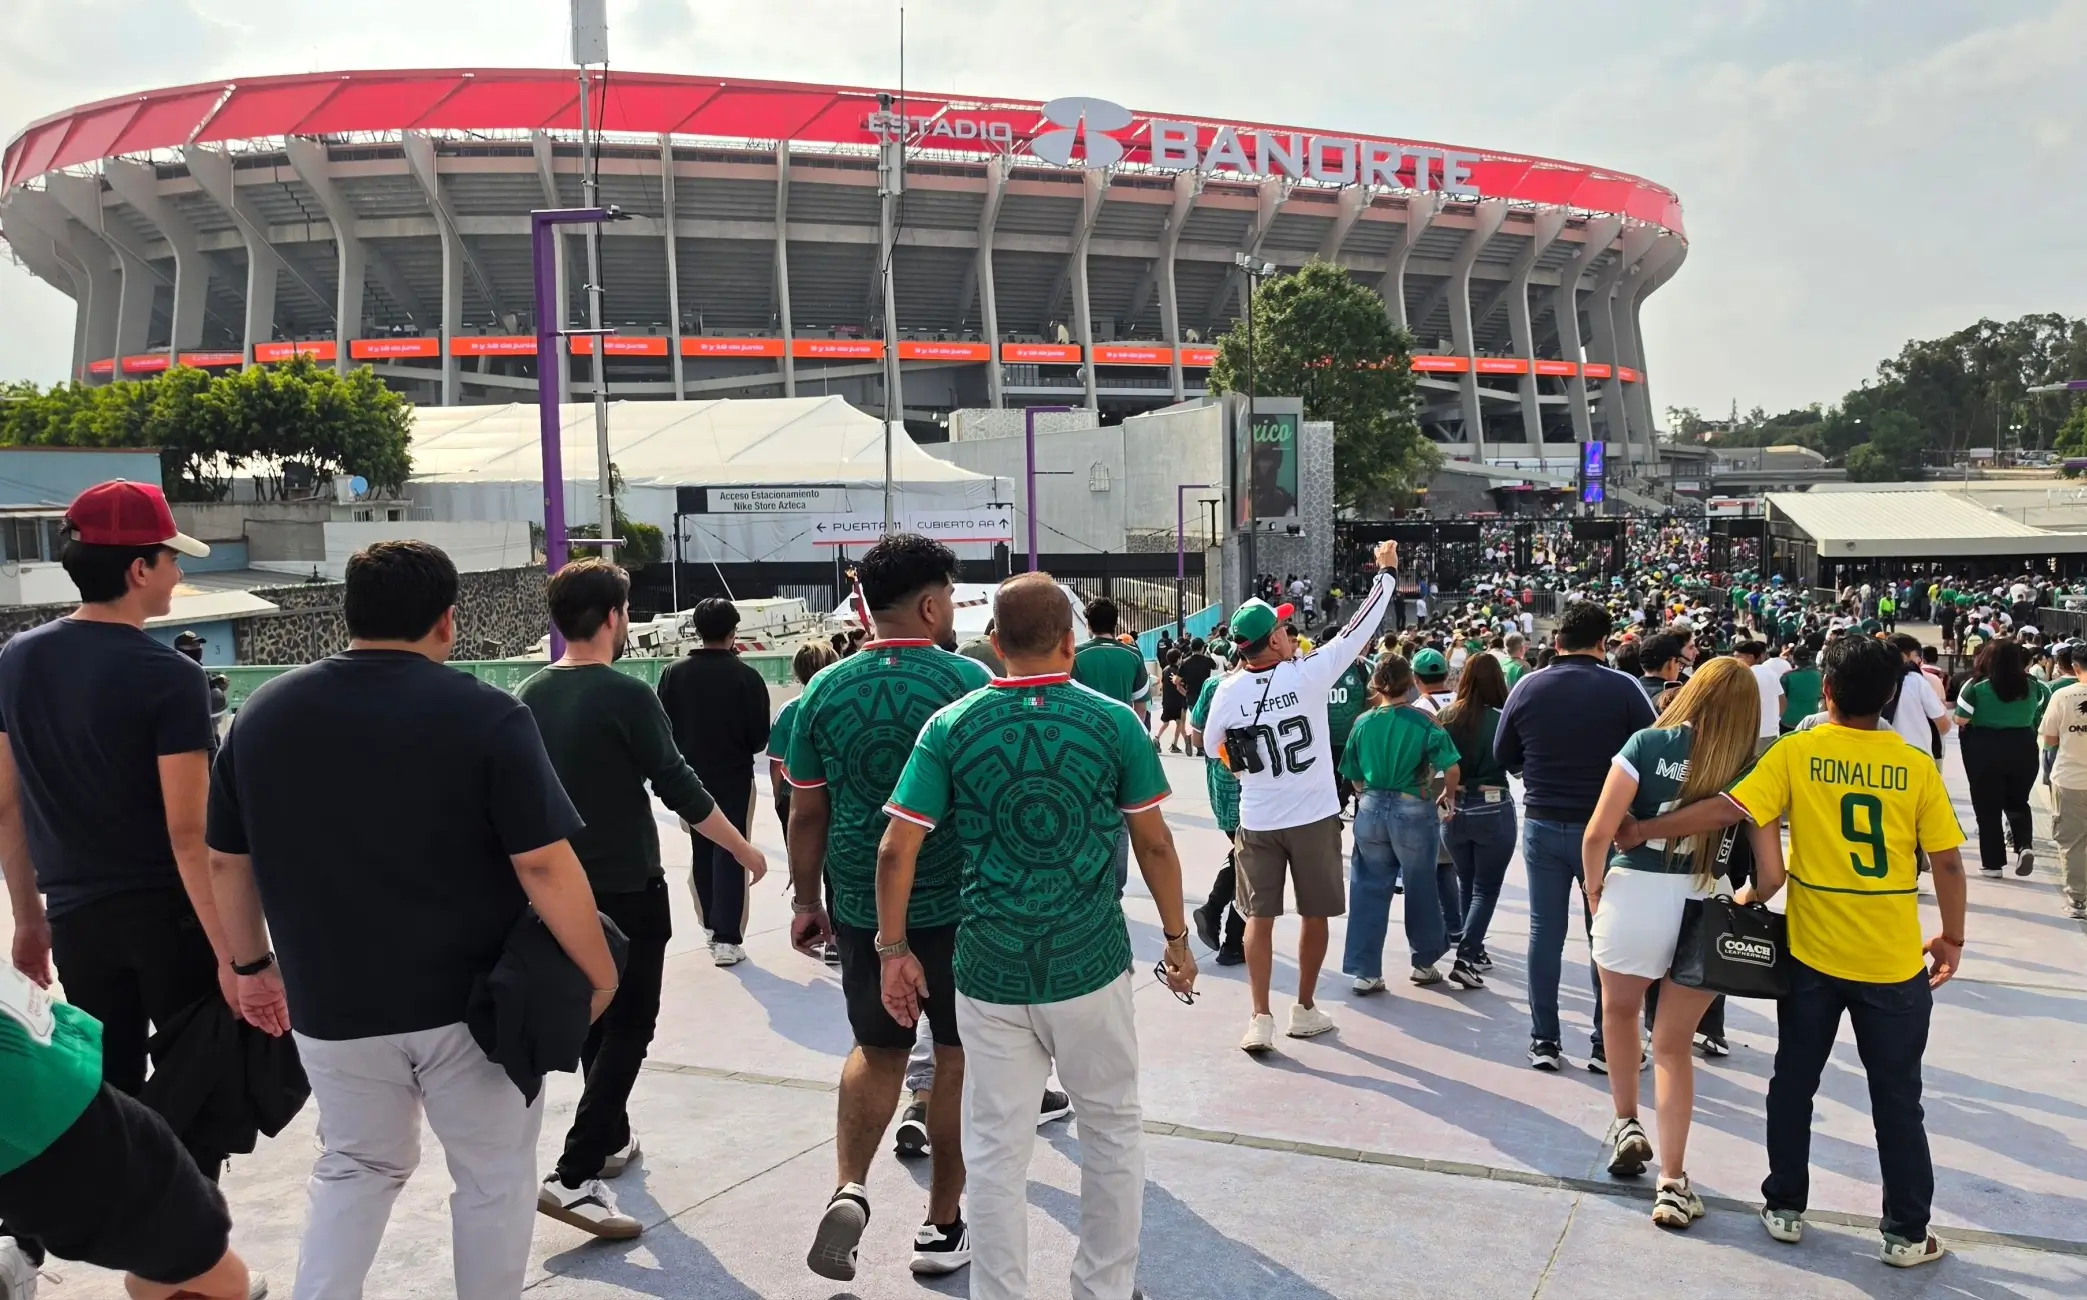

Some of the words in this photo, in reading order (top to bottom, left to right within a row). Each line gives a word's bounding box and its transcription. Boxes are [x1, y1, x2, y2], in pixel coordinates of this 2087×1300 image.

[868, 112, 1012, 141] ESTADIO
[1151, 119, 1481, 195] BANORTE
[720, 491, 749, 500] Acceso
[751, 489, 820, 500] Estacionamiento
[733, 502, 752, 511] Nike
[754, 501, 776, 510] Store
[778, 501, 806, 510] Azteca
[833, 522, 887, 532] PUERTA
[893, 521, 901, 531] 11
[917, 520, 975, 529] CUBIERTO
[978, 520, 995, 528] AA
[1240, 704, 1252, 717] L.
[1253, 691, 1299, 715] ZEPEDA
[1810, 756, 1908, 791] RONALDO
[1840, 792, 1889, 879] 9
[1724, 940, 1771, 956] COACH
[1724, 948, 1771, 961] LEATHERWARE
